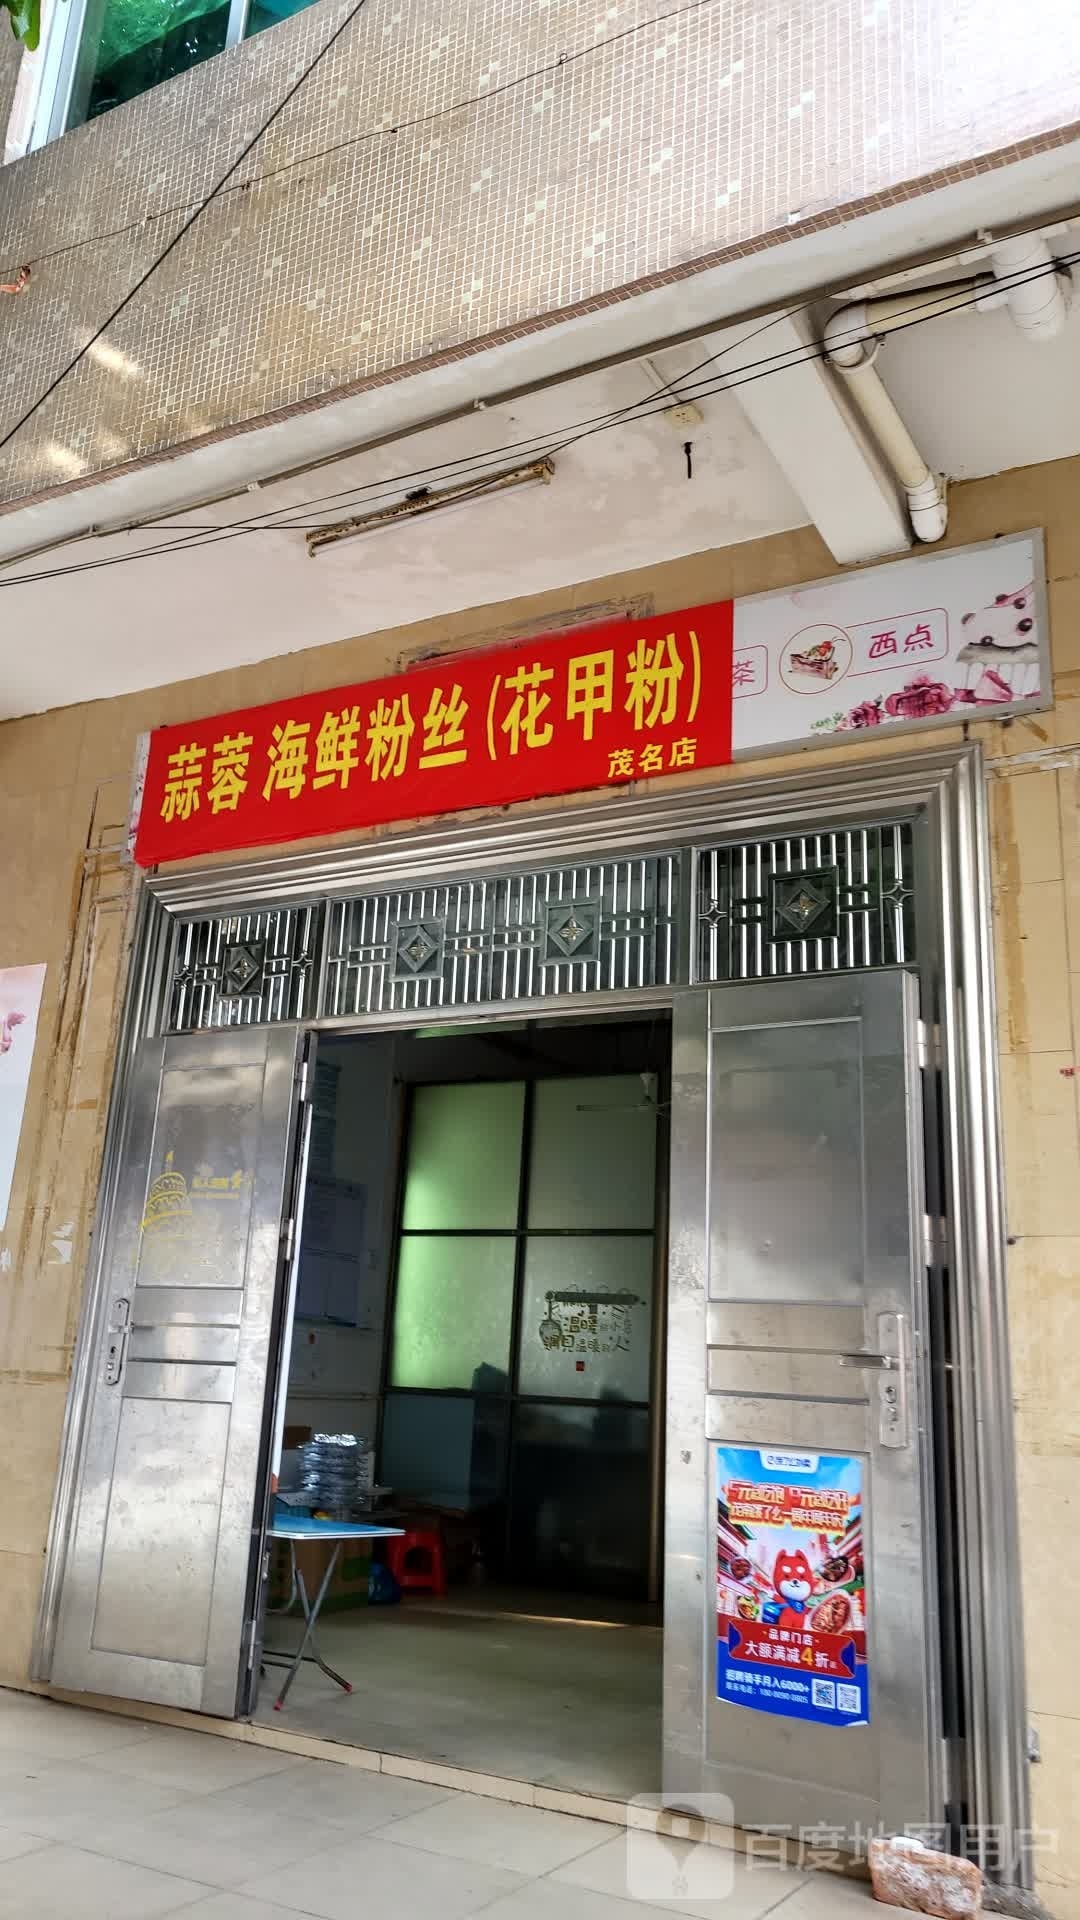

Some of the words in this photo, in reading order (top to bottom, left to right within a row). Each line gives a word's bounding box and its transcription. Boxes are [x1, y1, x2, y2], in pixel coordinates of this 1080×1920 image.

[868, 623, 934, 659] 西点
[607, 737, 697, 778] 茂名店
[768, 1629, 814, 1646] 品牌门店
